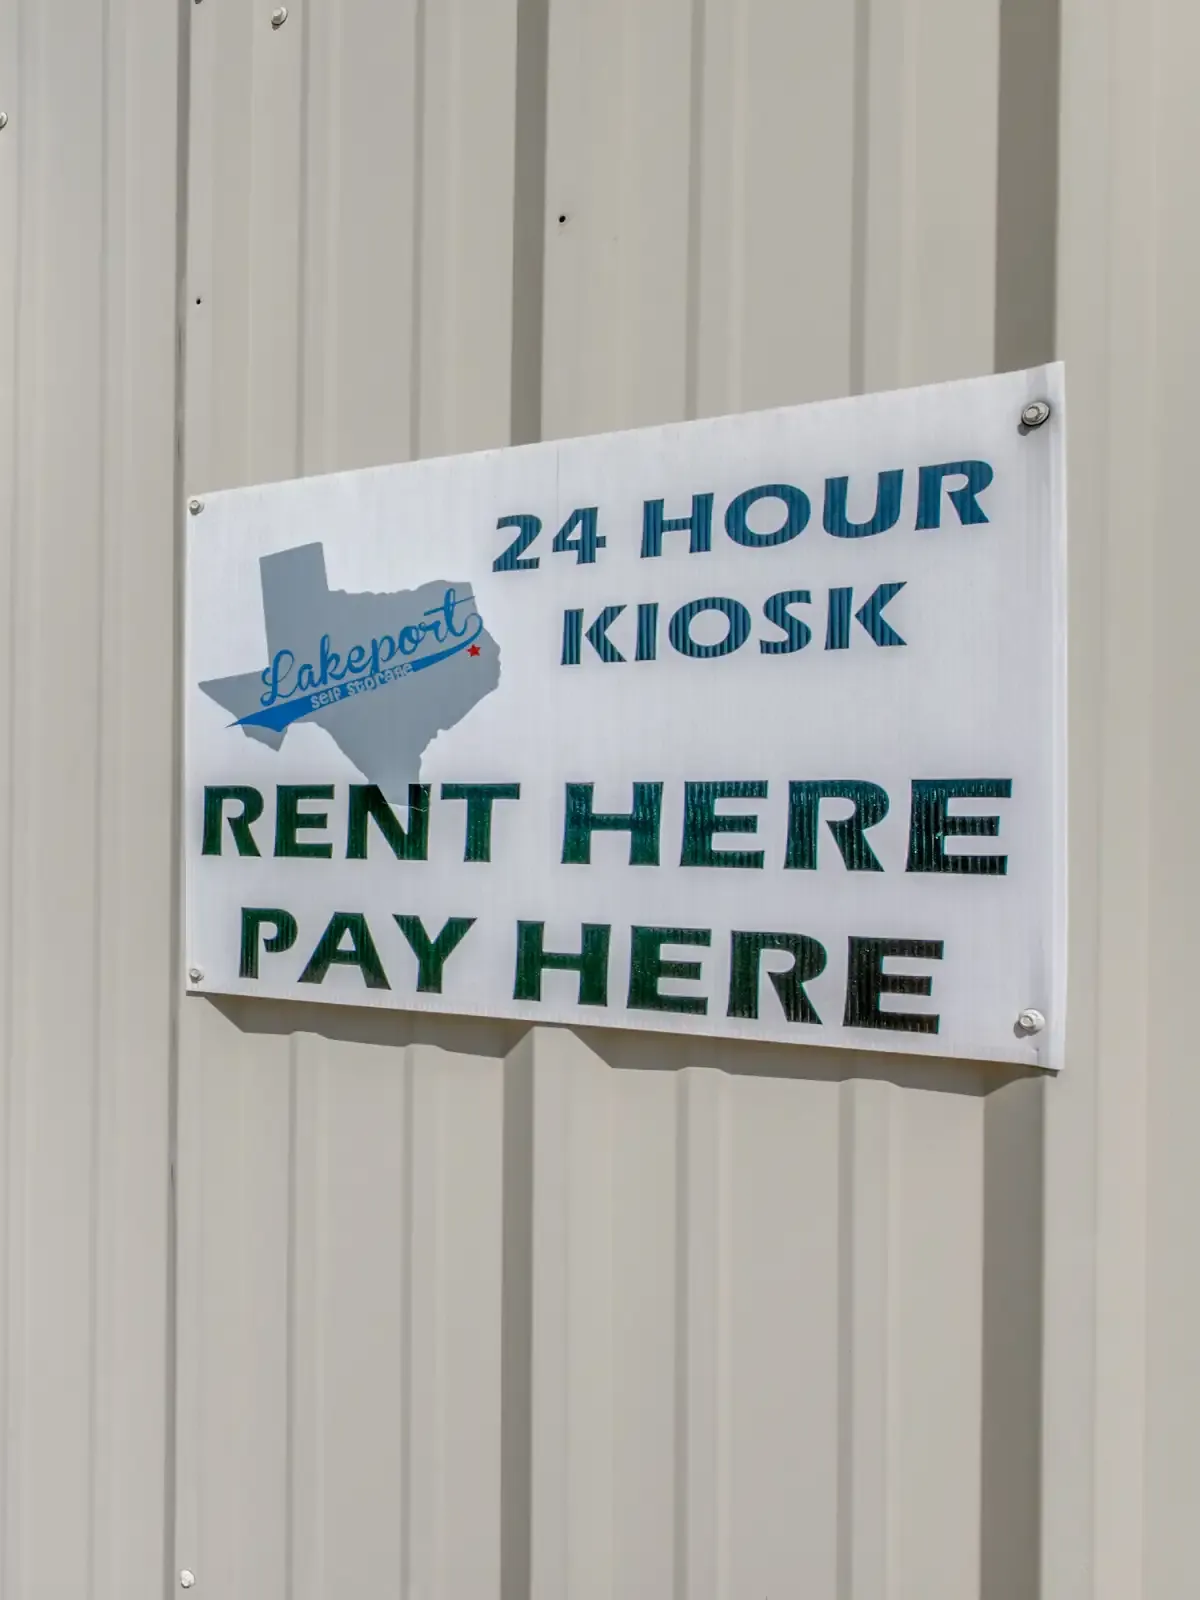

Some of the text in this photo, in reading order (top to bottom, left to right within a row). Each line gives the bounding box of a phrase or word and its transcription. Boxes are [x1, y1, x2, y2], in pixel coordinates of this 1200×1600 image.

[492, 459, 994, 573] 24 HOUR
[260, 587, 483, 707] Lakeport
[560, 581, 908, 666] KIOSK
[201, 777, 1013, 876] RENT HERE
[238, 906, 945, 1036] PAY HERE
